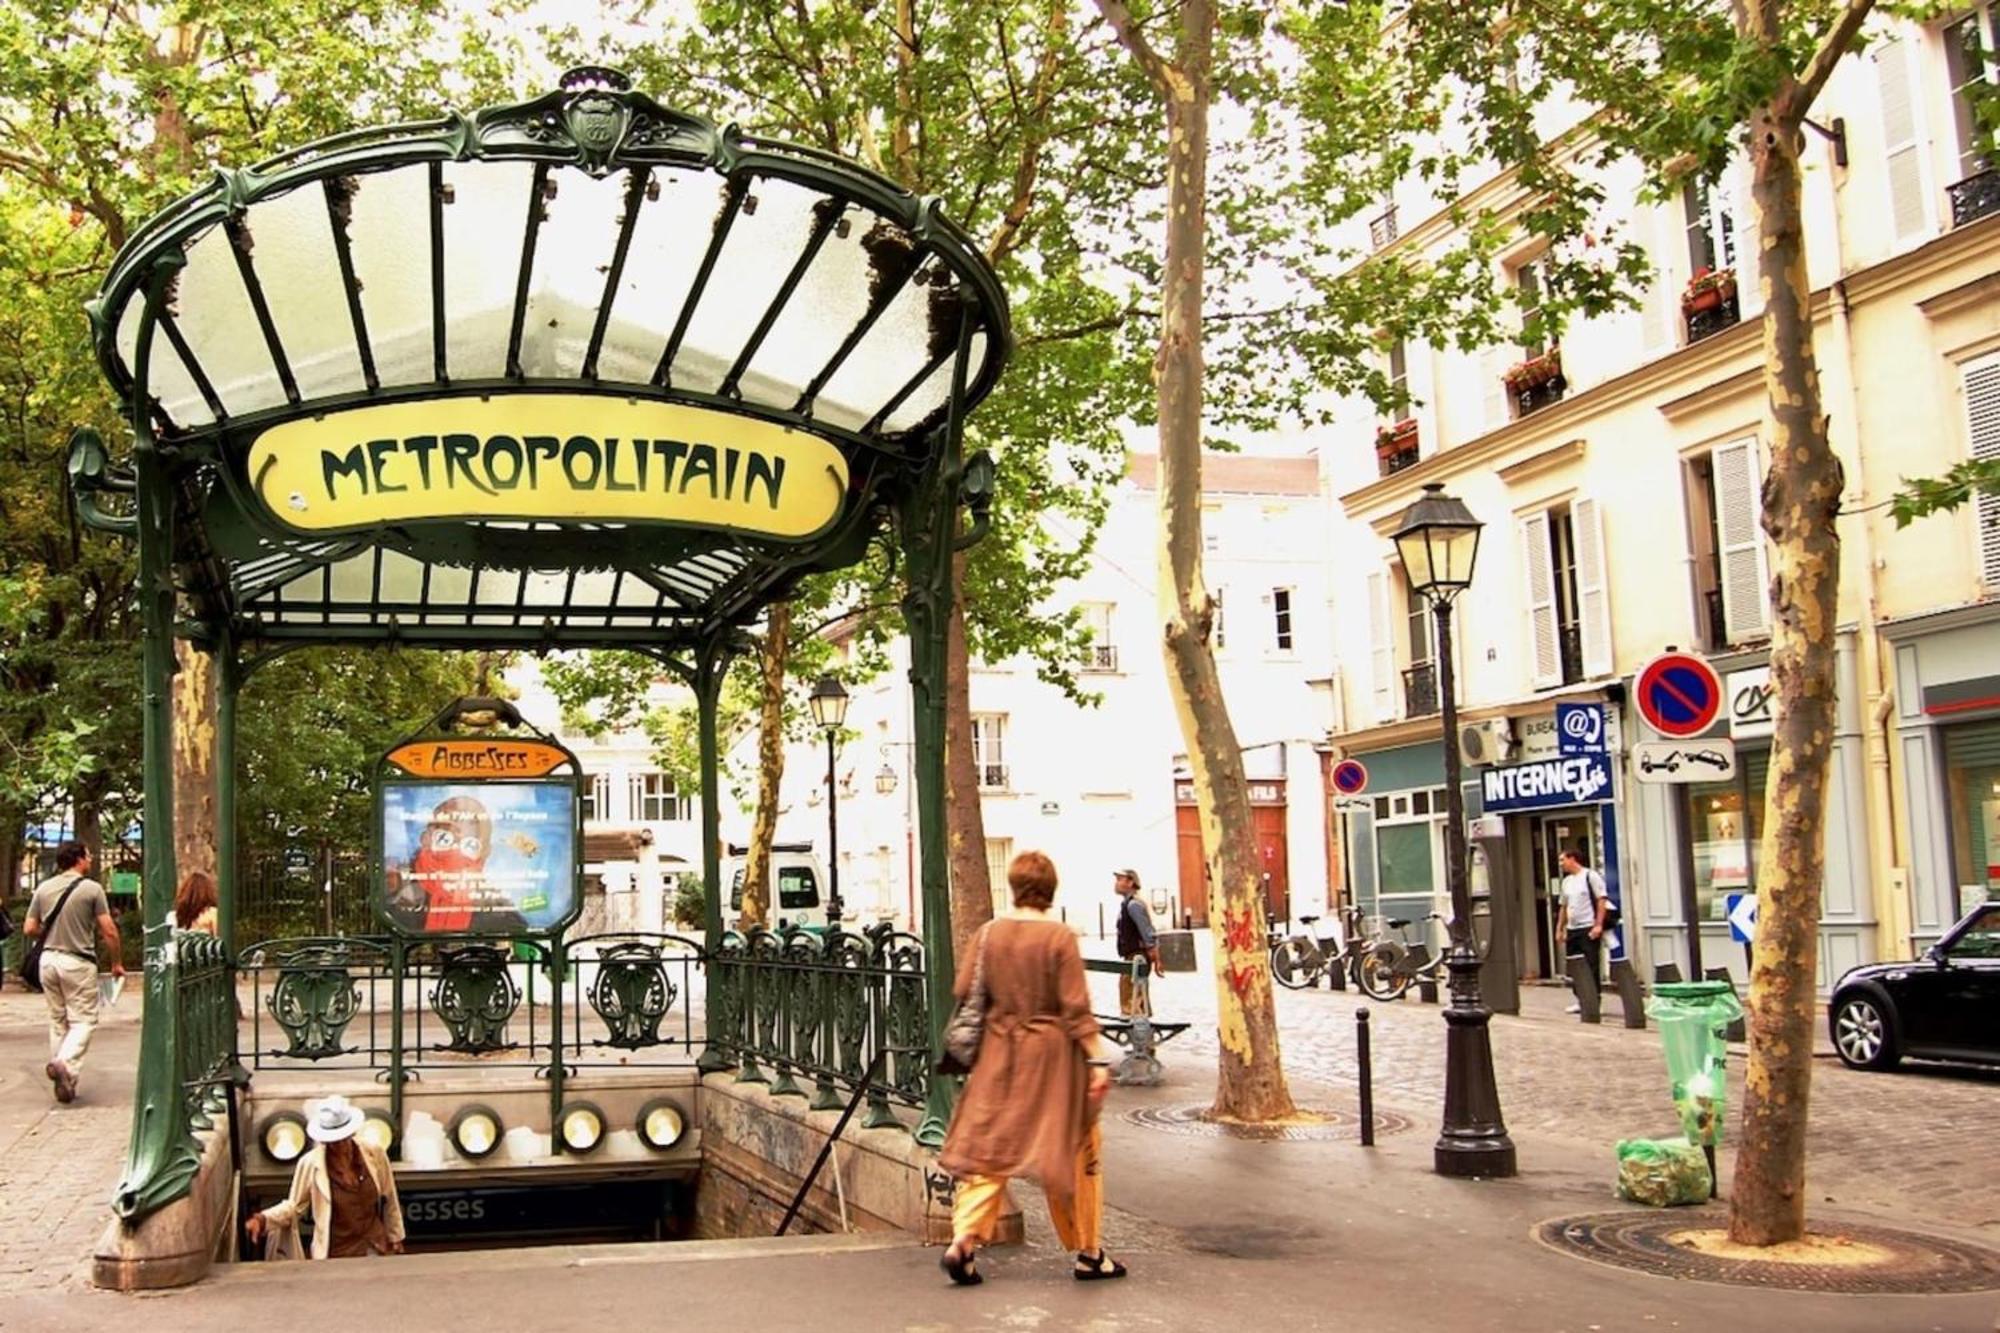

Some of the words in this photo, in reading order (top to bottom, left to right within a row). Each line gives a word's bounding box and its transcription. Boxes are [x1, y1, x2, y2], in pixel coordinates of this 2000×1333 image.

[321, 434, 785, 509] METROPOLITAIN
[1484, 758, 1592, 802] INTERNET
[402, 1199, 485, 1221] esses
